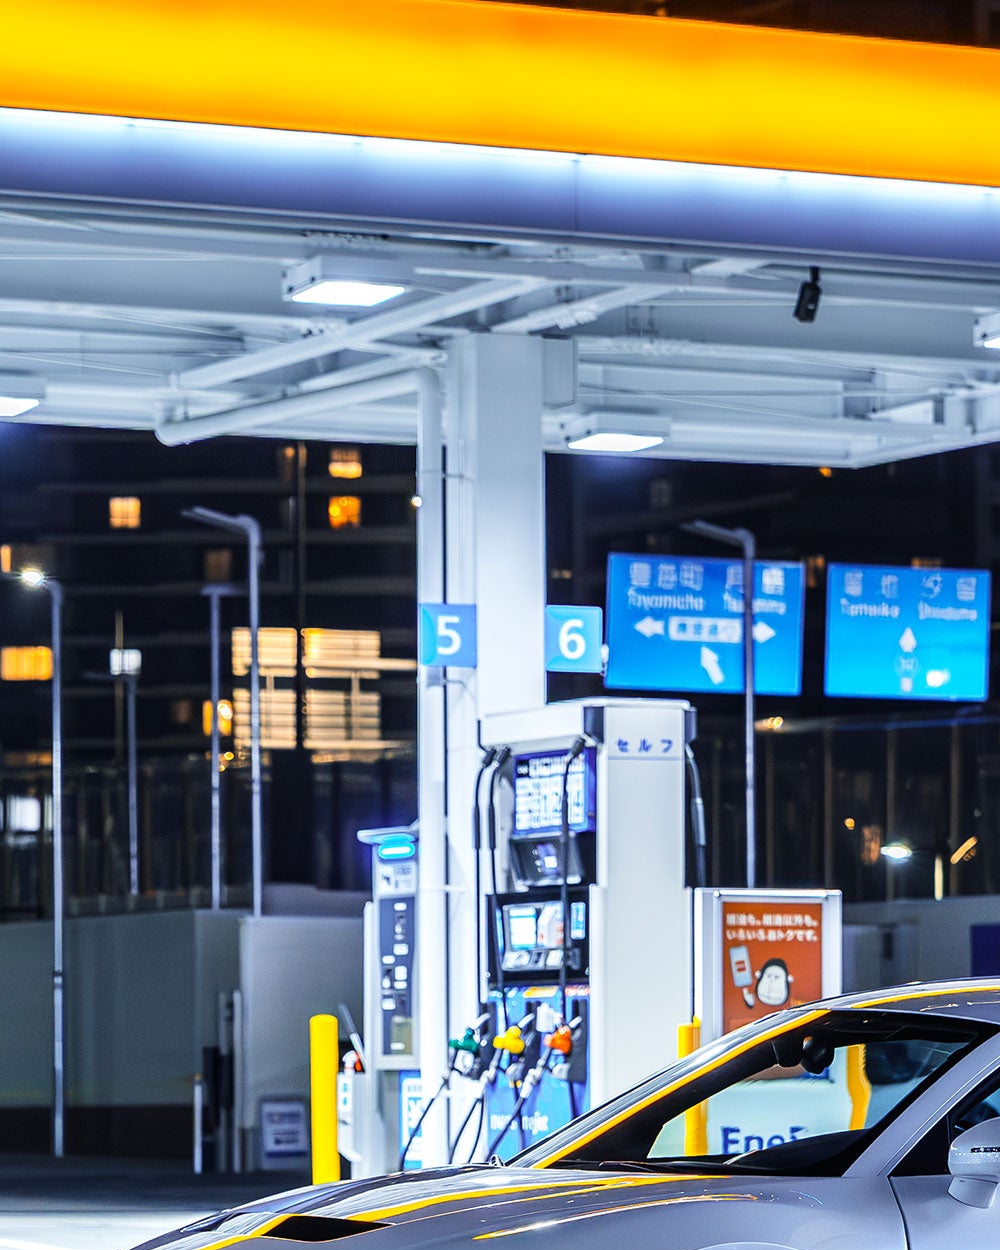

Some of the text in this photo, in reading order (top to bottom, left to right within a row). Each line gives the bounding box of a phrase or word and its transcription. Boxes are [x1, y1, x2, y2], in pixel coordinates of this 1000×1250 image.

[437, 616, 461, 655] 5
[559, 619, 586, 660] 6
[617, 738, 673, 753] セルフ
